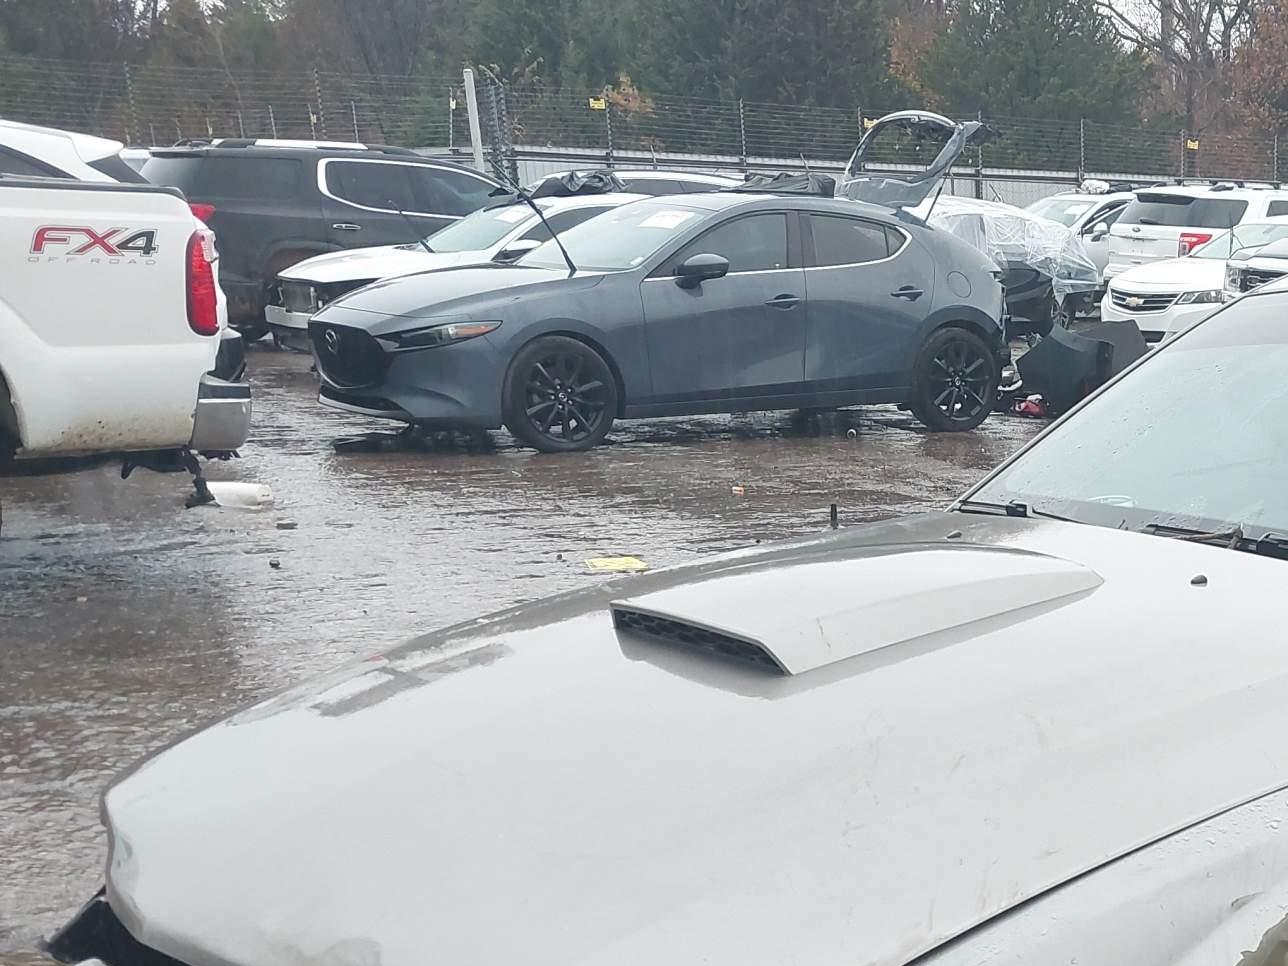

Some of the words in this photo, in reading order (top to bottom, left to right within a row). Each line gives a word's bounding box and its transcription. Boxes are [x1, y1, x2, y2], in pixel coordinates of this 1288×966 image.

[29, 224, 159, 257] FX4
[27, 256, 75, 264] OFF
[90, 257, 157, 266] ROAD
